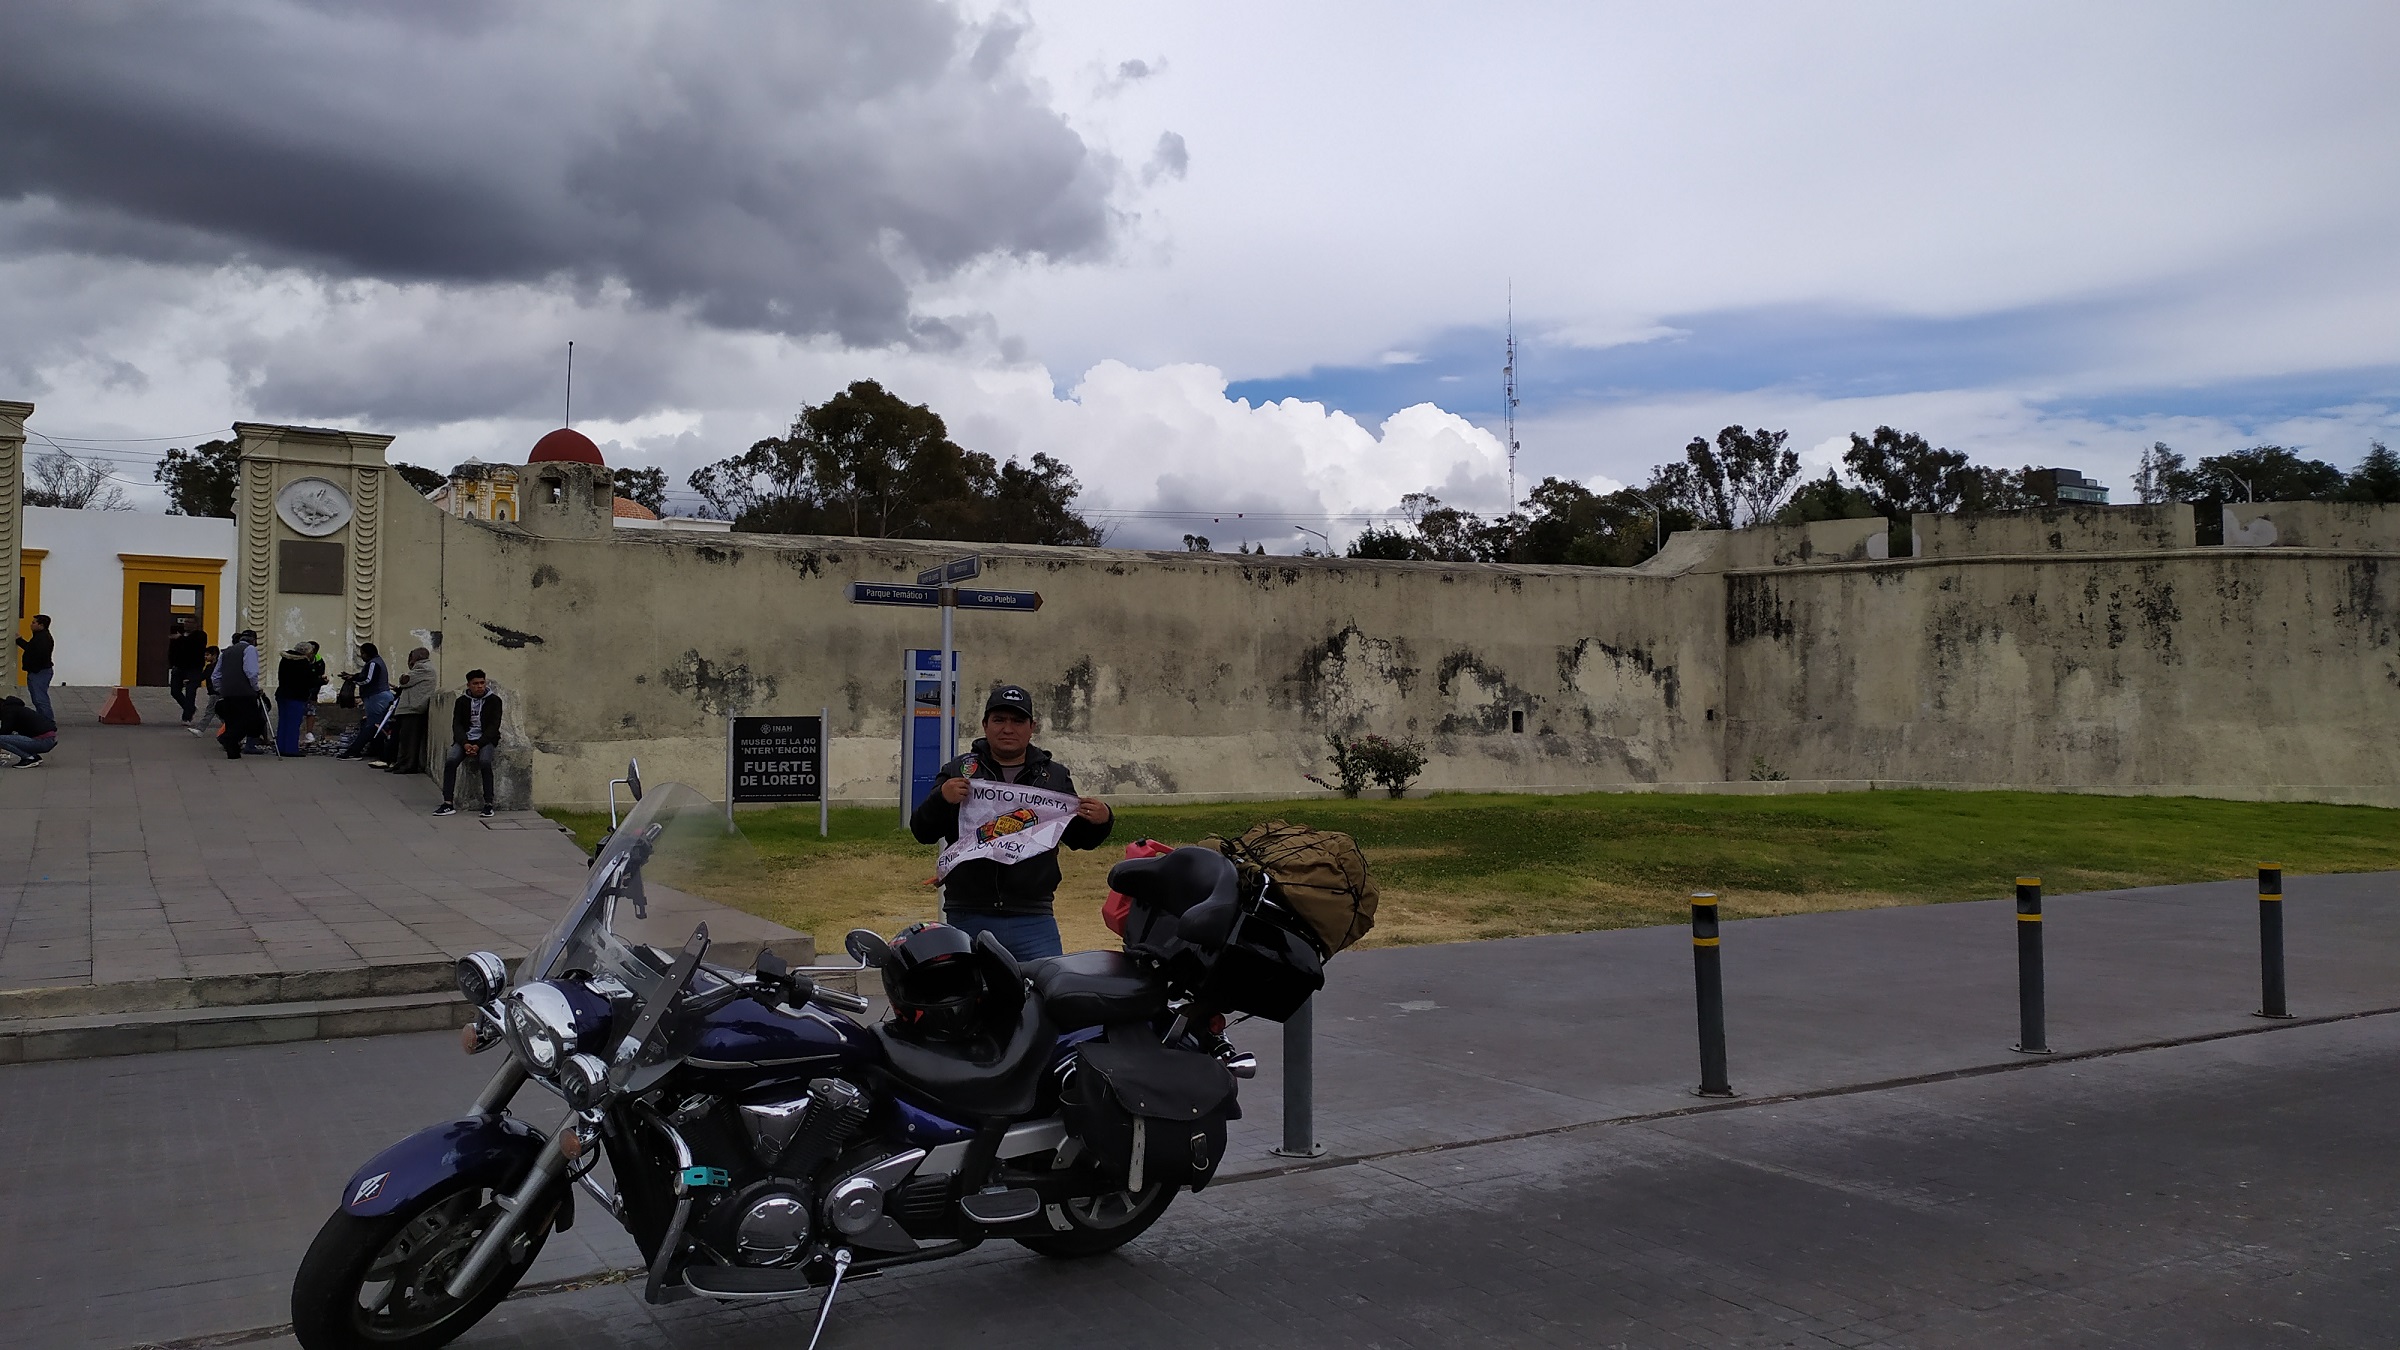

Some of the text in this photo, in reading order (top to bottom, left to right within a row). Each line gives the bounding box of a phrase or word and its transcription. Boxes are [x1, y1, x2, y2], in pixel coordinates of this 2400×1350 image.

[866, 588, 929, 600] Parque Temático 1
[977, 594, 1017, 604] Casa Puebla
[803, 737, 817, 745] NO
[744, 761, 812, 773] FUERTE
[740, 774, 816, 786] DE LORETO
[973, 788, 1068, 813] MOTO TURISTA
